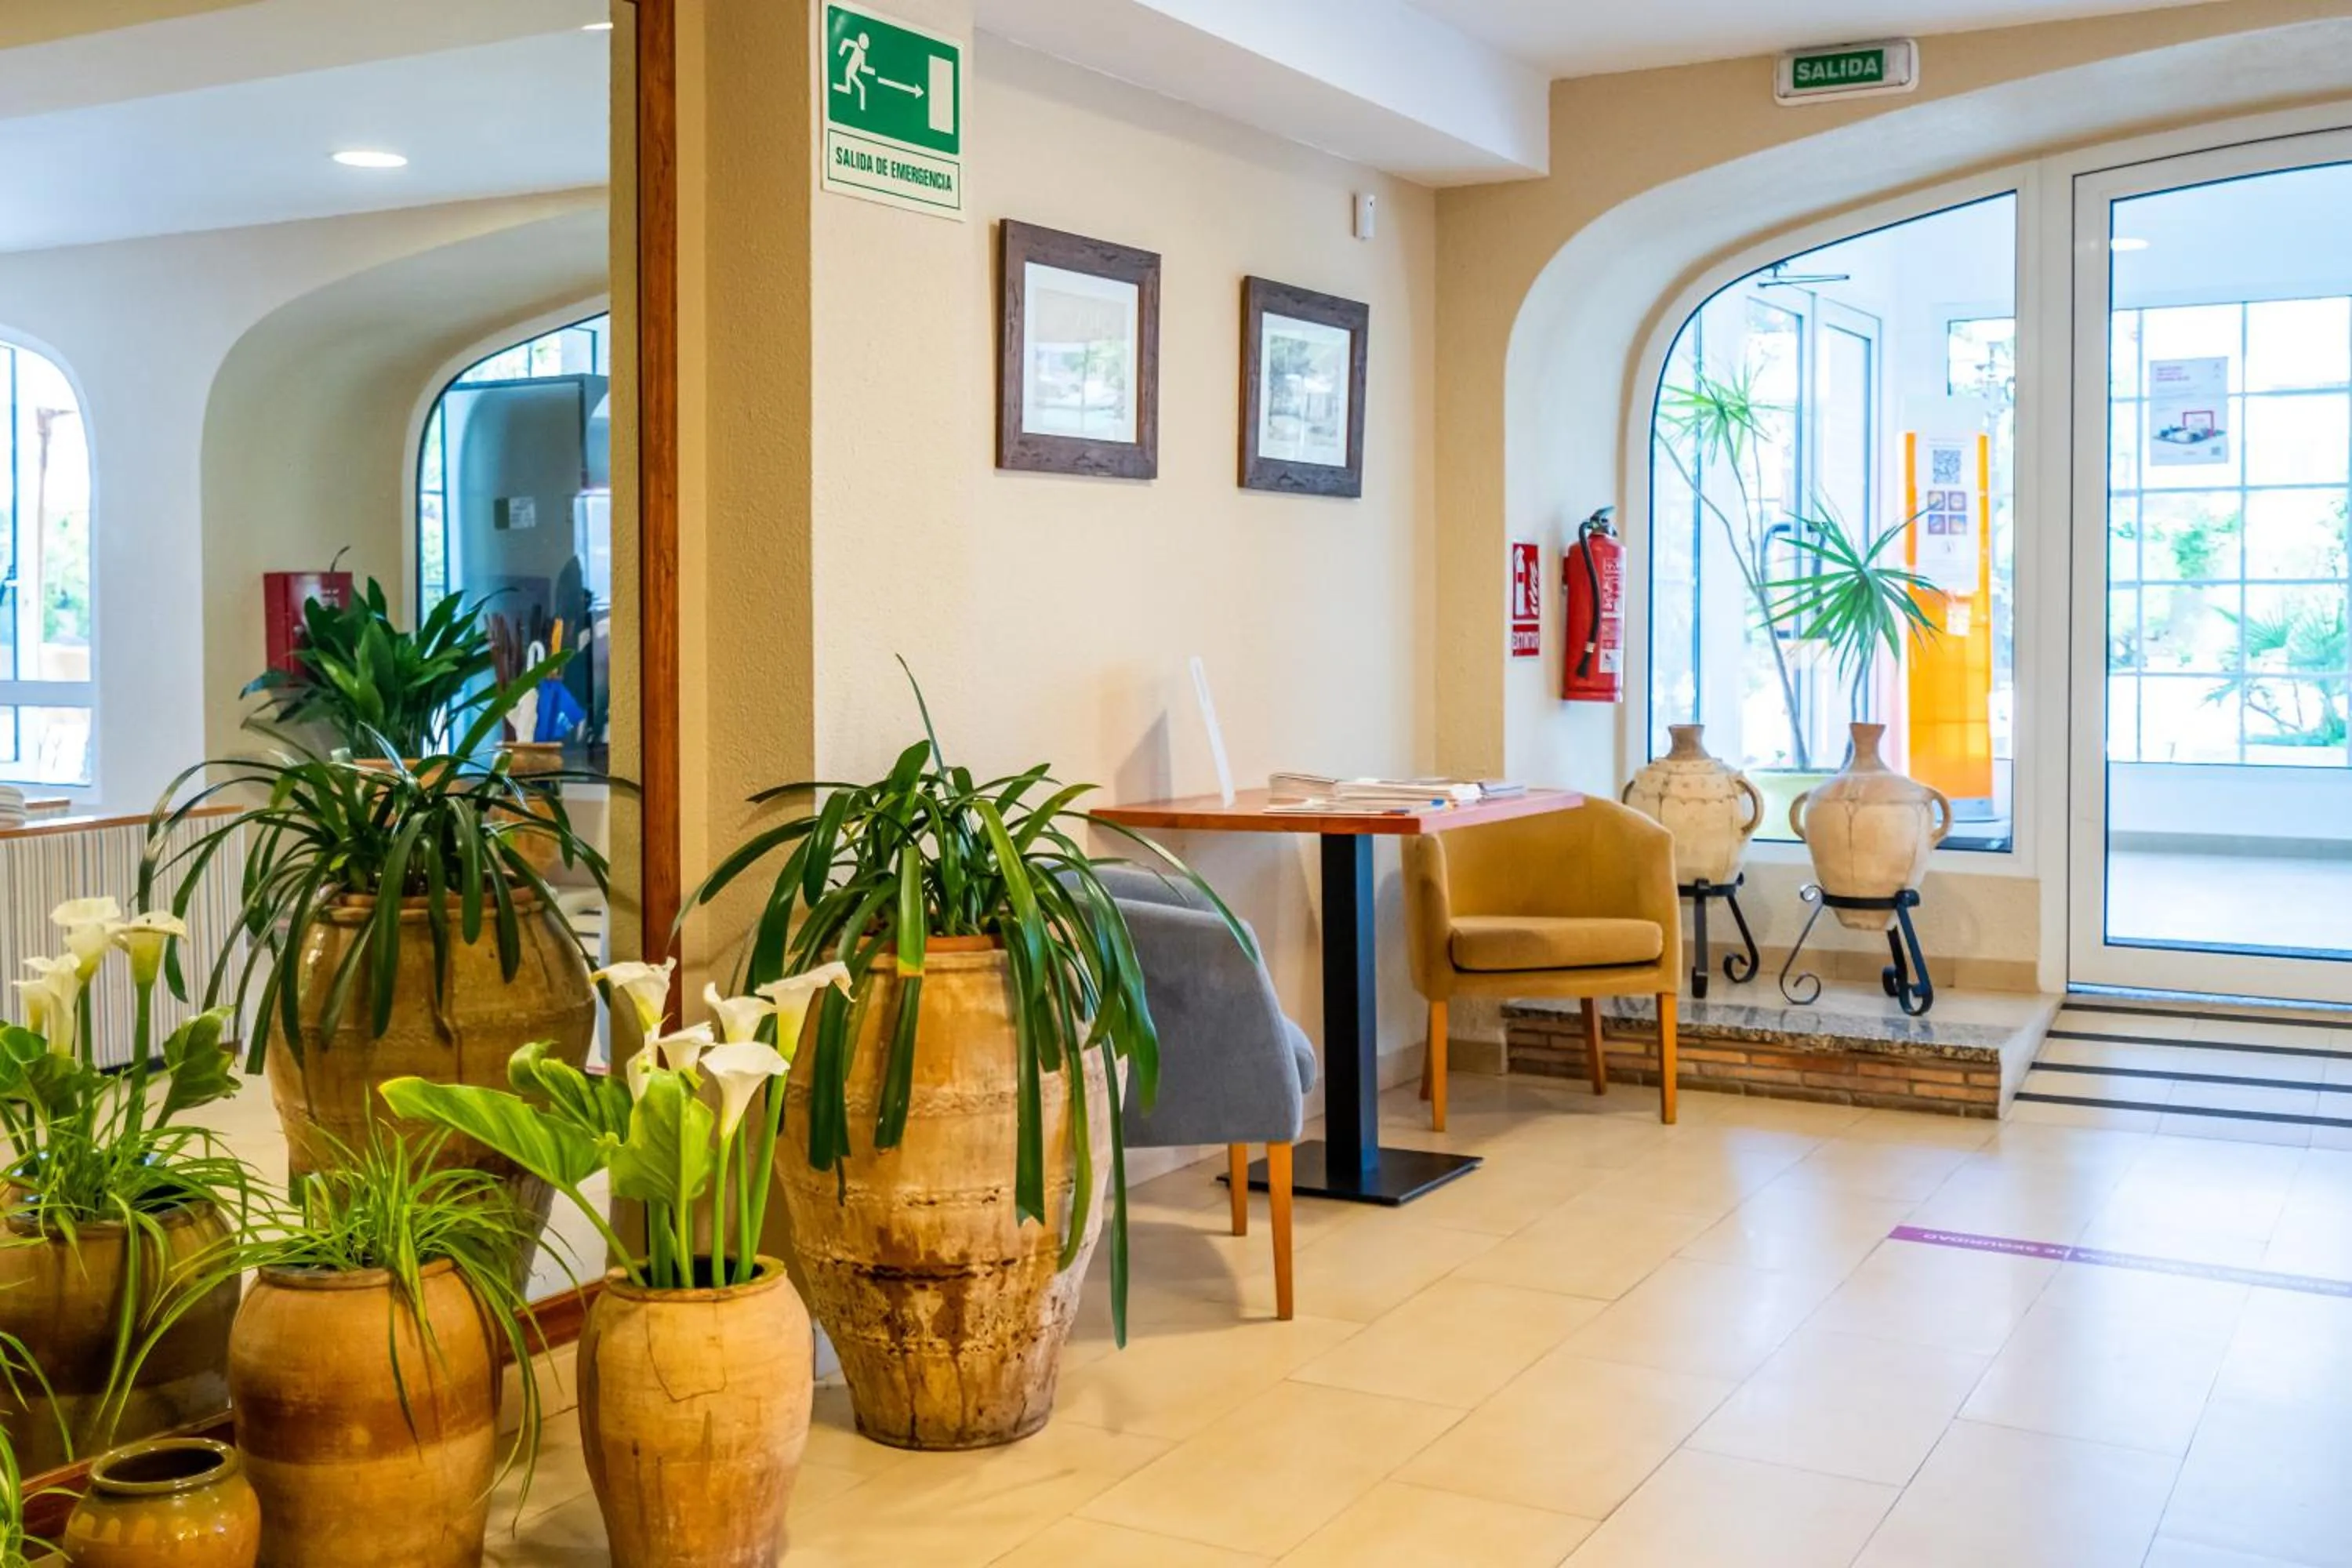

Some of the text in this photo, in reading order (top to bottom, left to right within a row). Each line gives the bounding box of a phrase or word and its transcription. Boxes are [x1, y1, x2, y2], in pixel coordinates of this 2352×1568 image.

[1796, 56, 1878, 81] SALIDA
[836, 147, 953, 191] SALIDA DE EMERGENCIA
